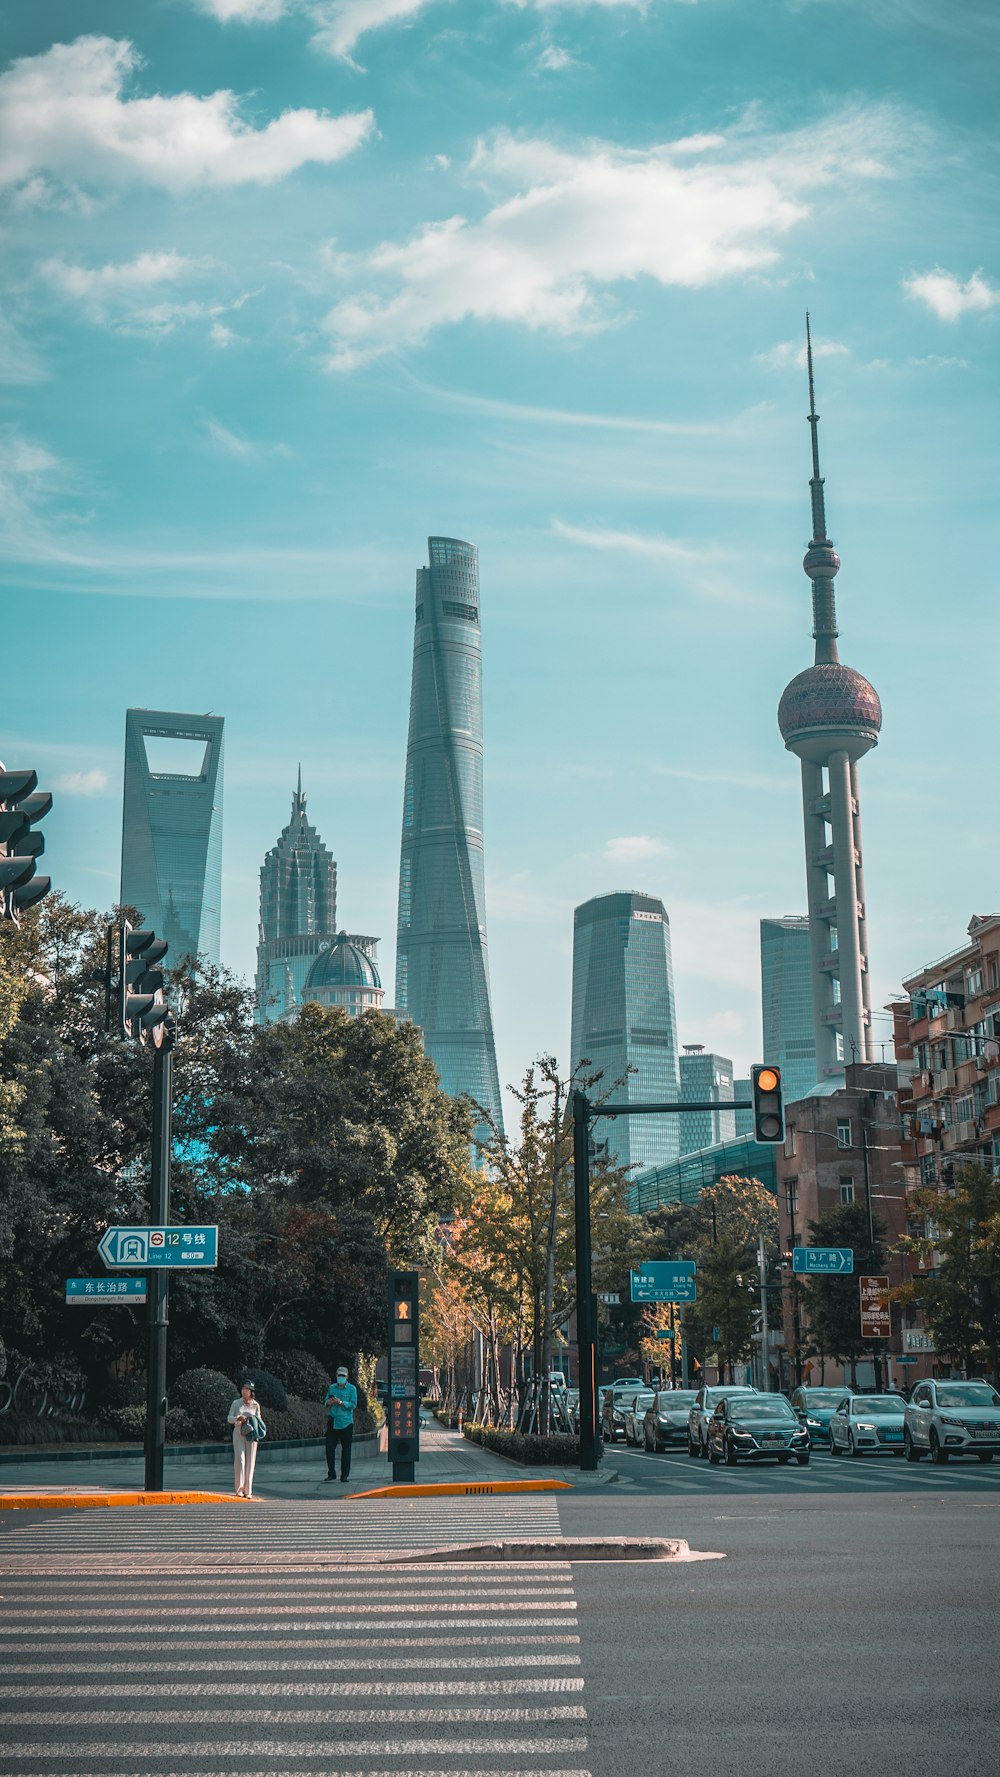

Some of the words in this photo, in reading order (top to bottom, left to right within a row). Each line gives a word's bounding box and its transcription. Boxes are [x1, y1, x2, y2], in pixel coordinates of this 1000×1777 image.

[148, 1252, 162, 1260] Line
[164, 1252, 172, 1260] 12
[809, 1252, 837, 1262] 马厂路
[84, 1282, 128, 1293] 东长治路
